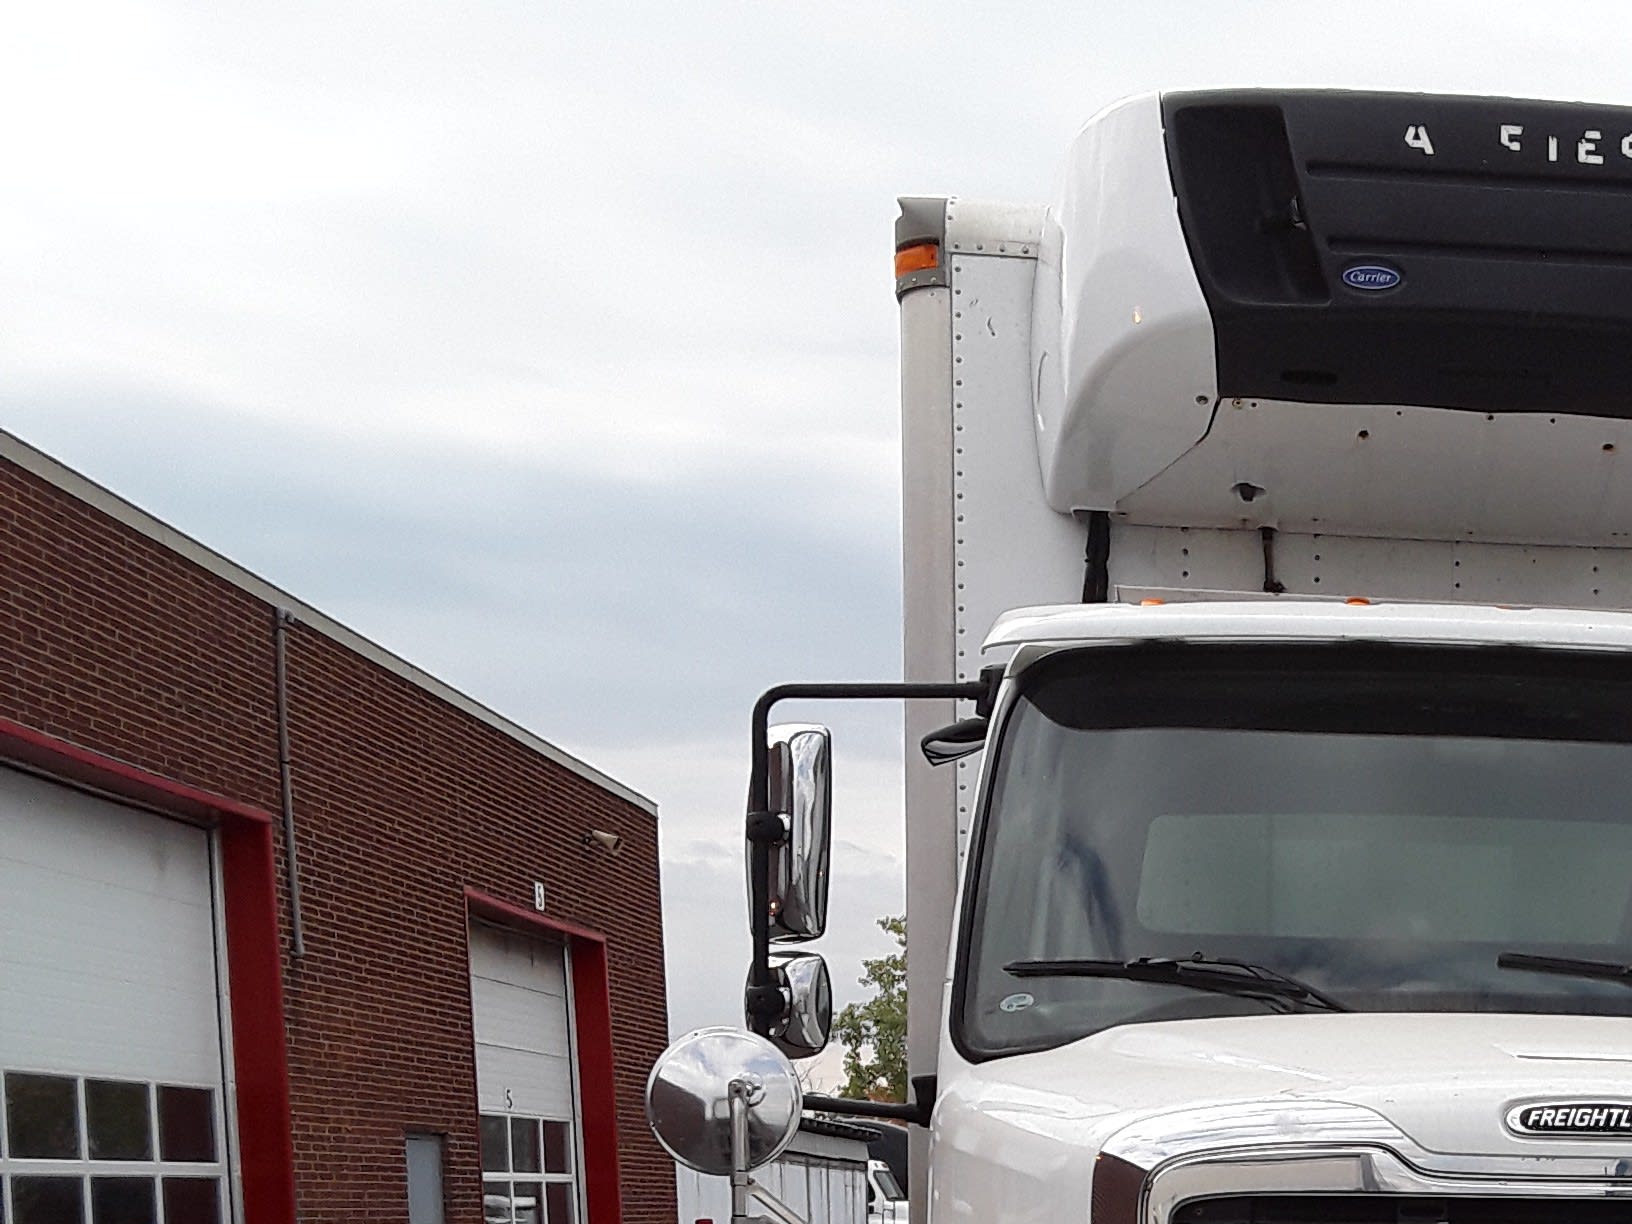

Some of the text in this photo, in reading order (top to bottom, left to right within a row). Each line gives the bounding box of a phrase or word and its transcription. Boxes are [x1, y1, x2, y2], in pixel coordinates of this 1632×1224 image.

[1350, 271, 1391, 283] Carrier
[537, 885, 543, 907] 5
[506, 1088, 513, 1109] 5
